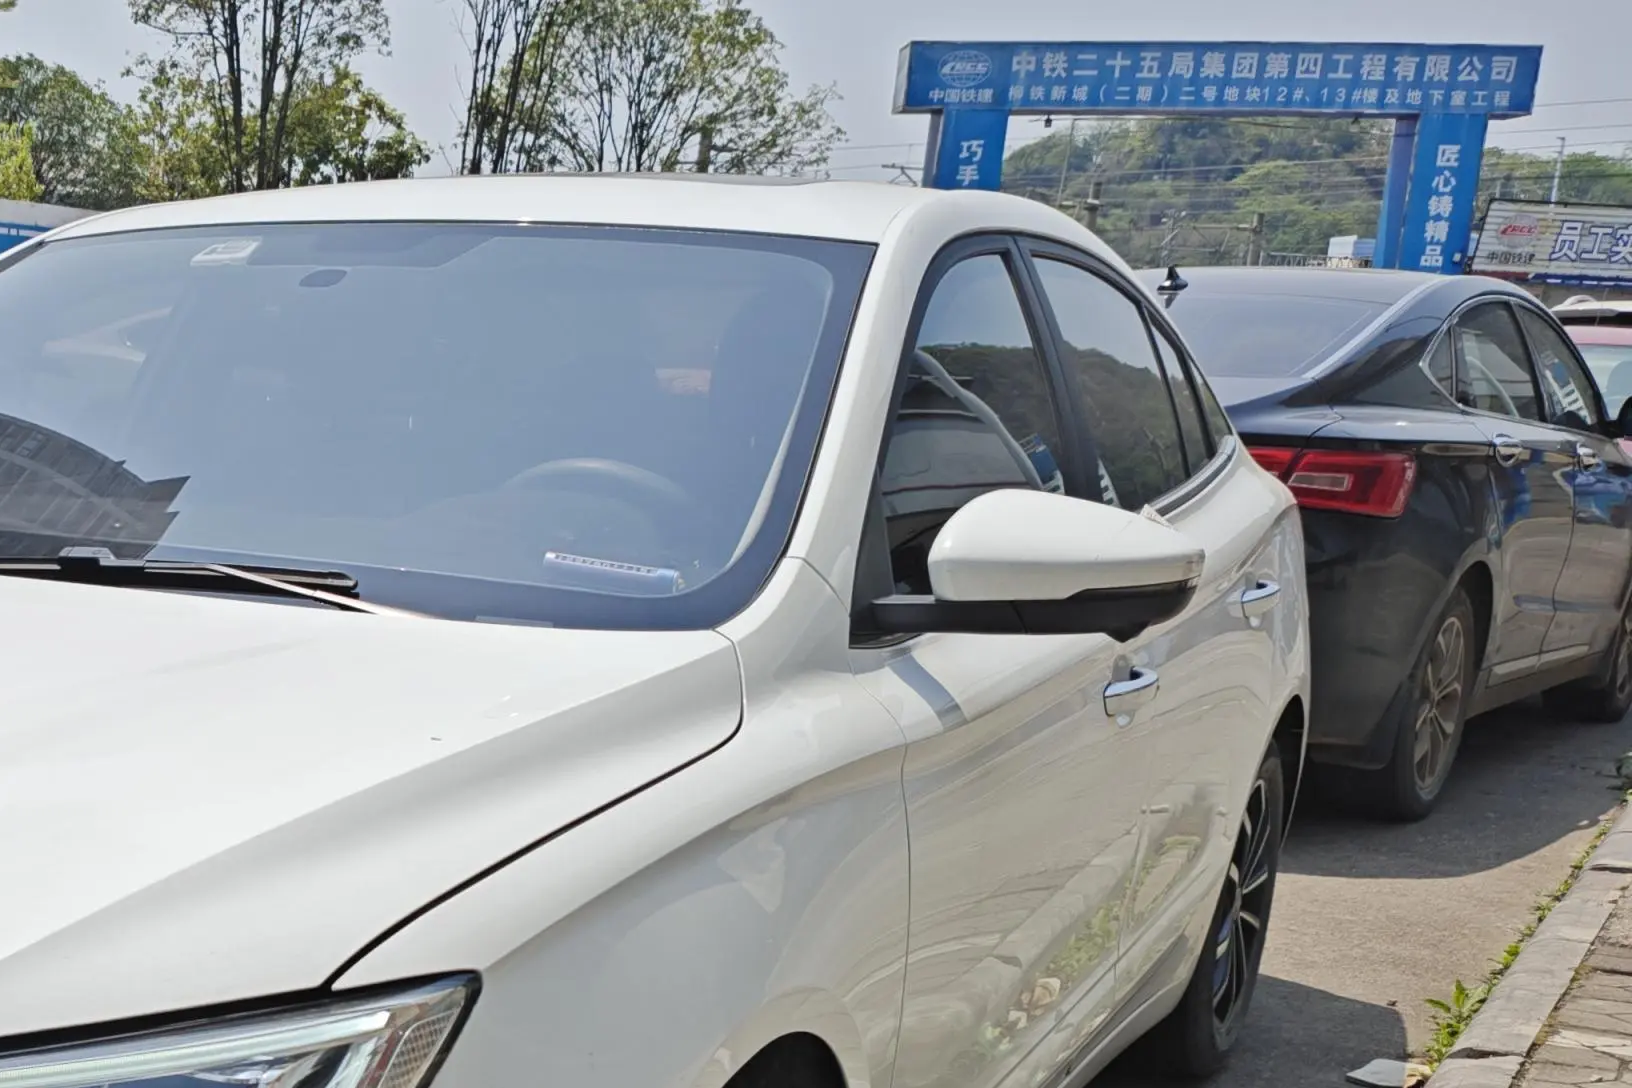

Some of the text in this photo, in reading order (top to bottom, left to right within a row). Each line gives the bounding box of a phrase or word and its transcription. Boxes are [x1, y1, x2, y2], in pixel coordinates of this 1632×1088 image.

[1011, 50, 1518, 82] 中铁二十五局集团第四工程有限公司
[955, 139, 985, 187] 巧手
[1419, 144, 1462, 268] 匠心铸精品
